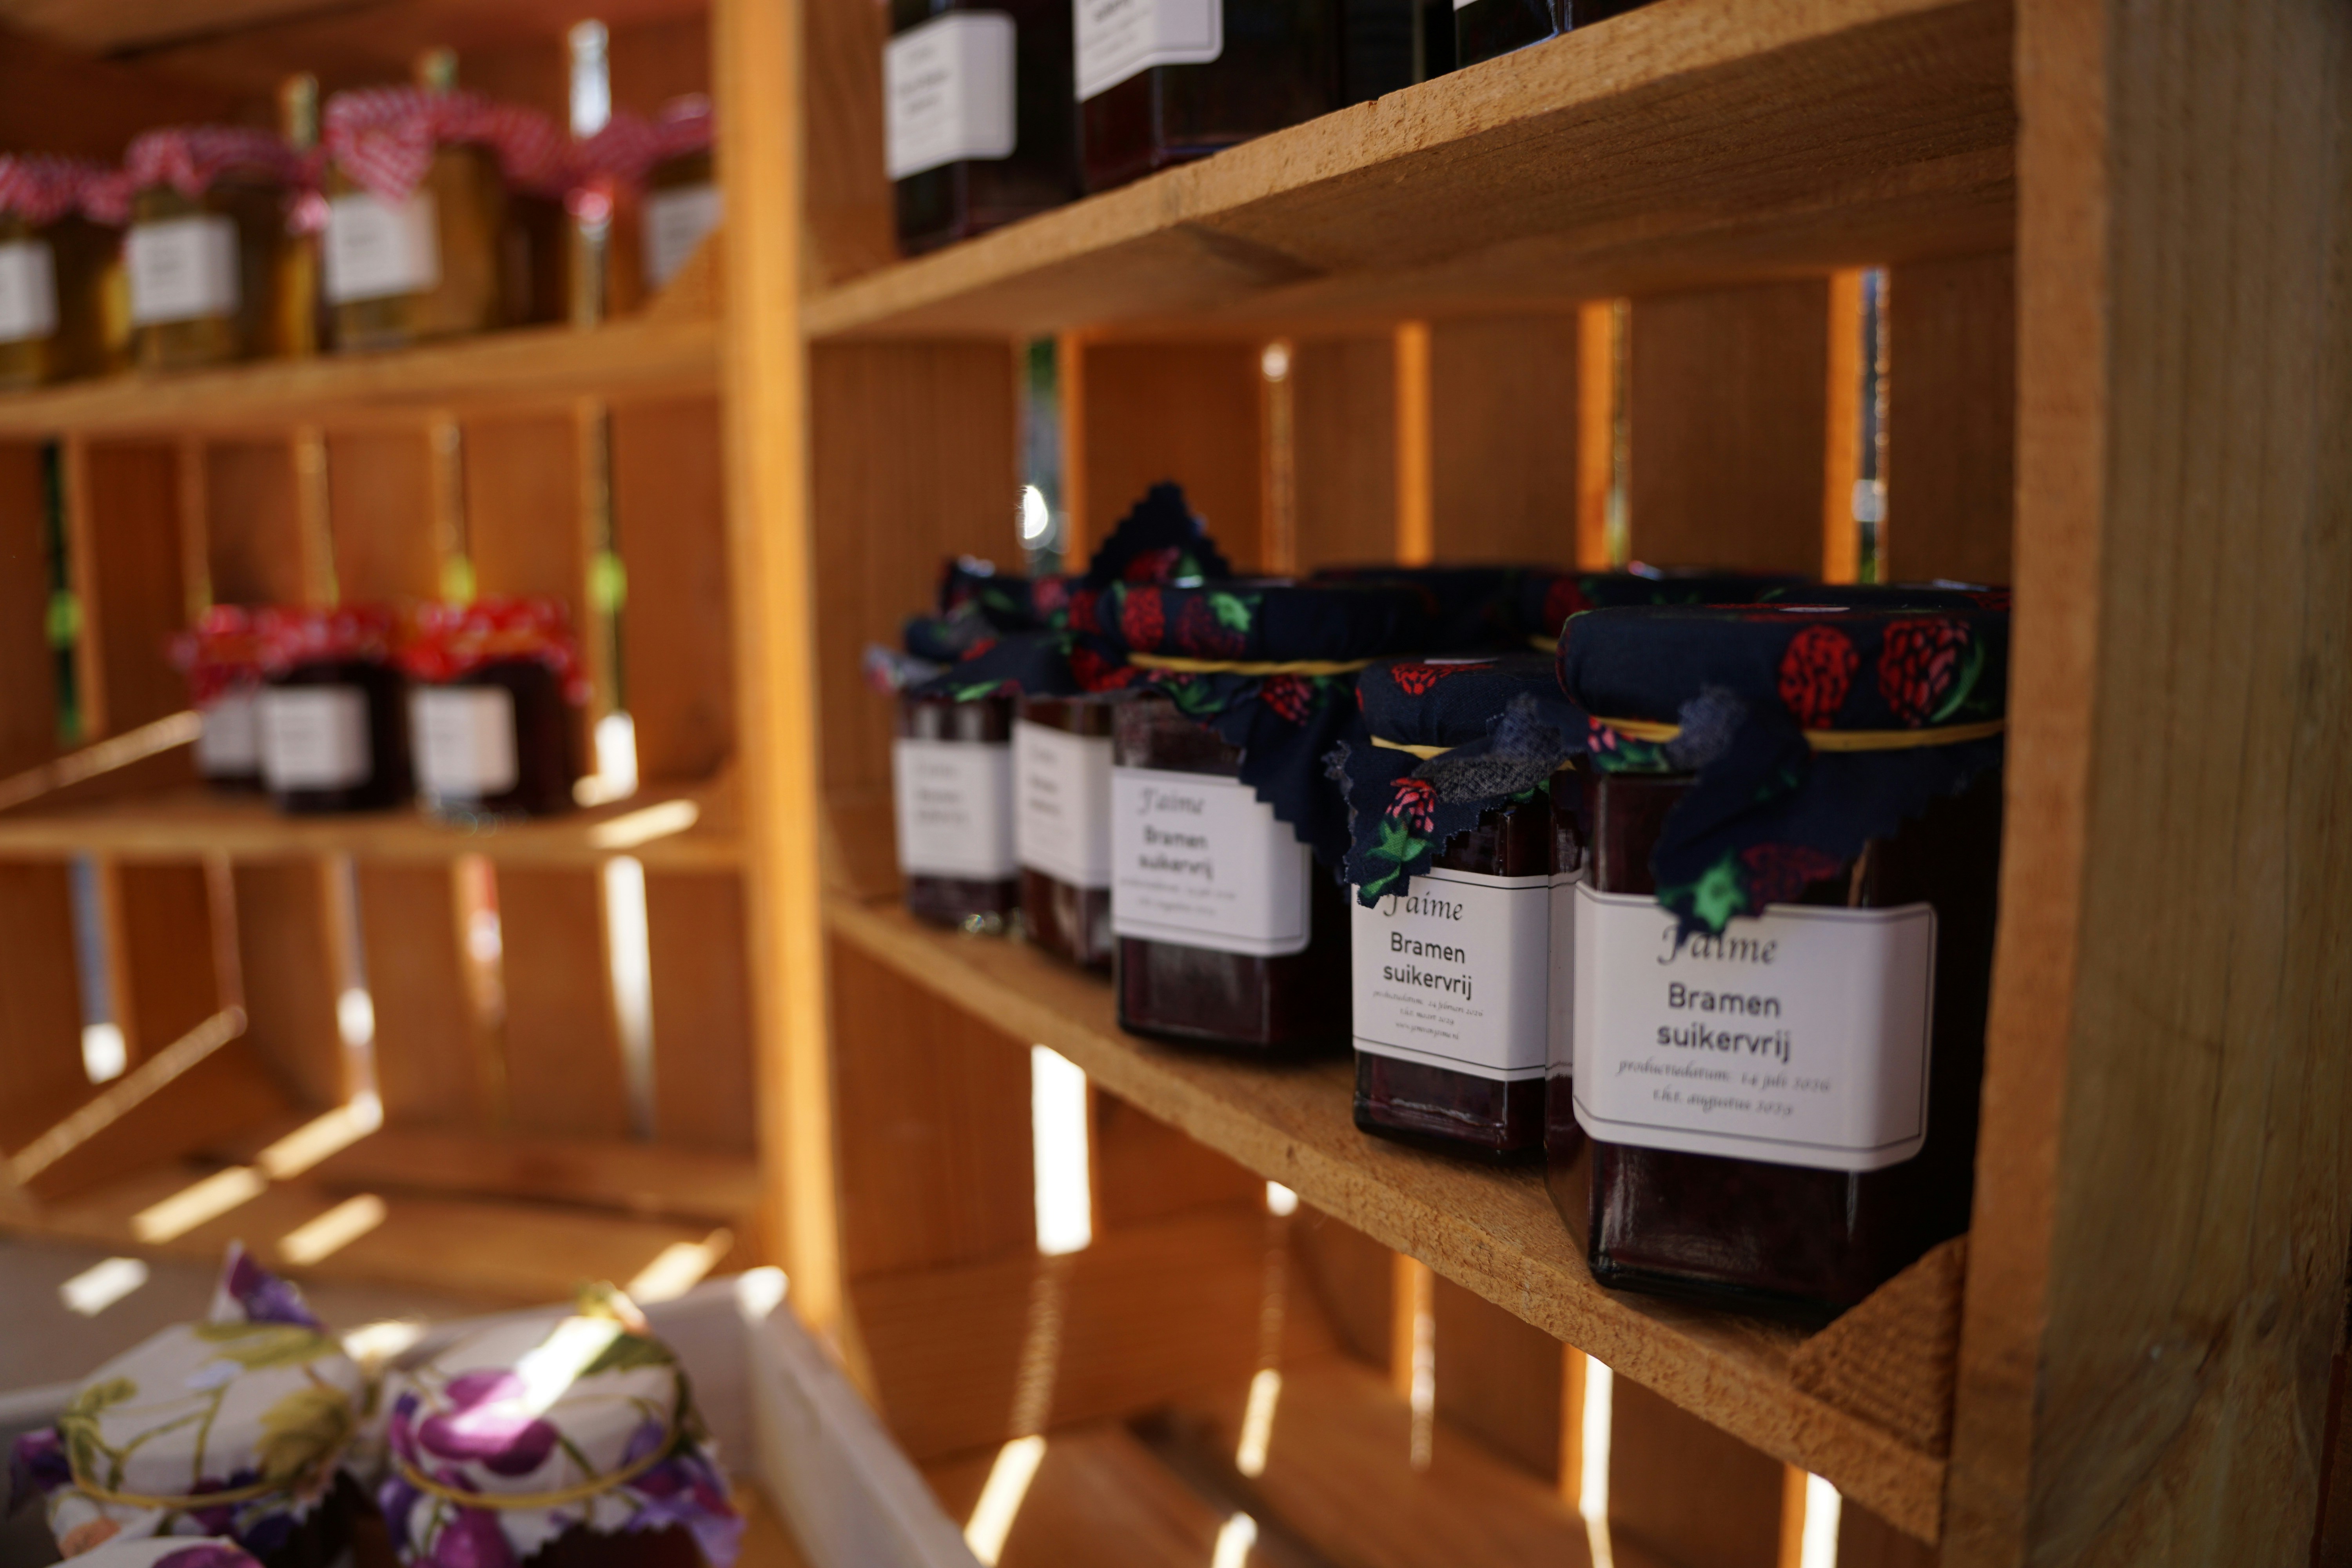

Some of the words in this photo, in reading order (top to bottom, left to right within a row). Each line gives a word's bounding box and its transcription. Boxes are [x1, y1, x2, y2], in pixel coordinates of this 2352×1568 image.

[1383, 891, 1463, 921] Jaime
[1391, 931, 1465, 964] Bramen
[1656, 925, 1777, 964] Jaime
[1383, 964, 1472, 1000] suikervrij
[1668, 981, 1780, 1017] Bramen
[1657, 1021, 1790, 1063] suikervrij
[1759, 1069, 1788, 1091] juli
[1687, 1093, 1751, 1114] augustus
